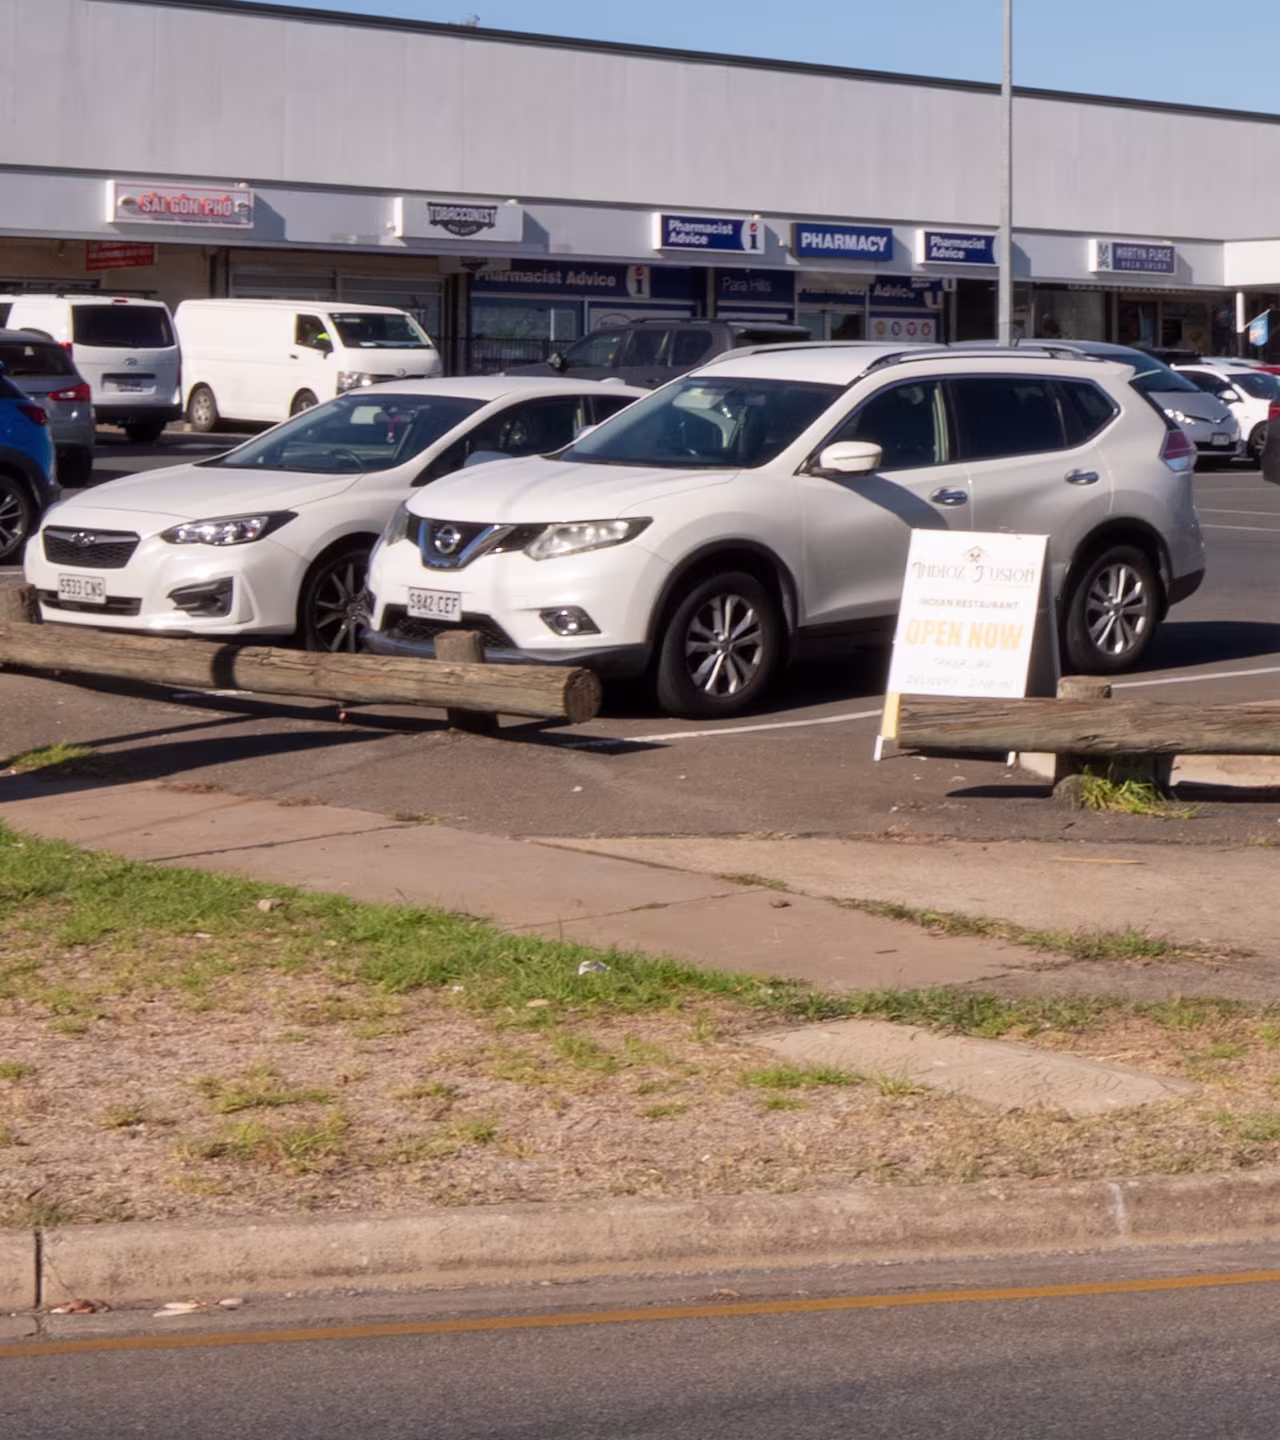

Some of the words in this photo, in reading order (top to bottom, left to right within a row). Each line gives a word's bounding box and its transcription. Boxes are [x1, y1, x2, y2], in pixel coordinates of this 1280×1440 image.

[429, 206, 496, 225] TOBACCONIST
[668, 219, 733, 235] Pharmacist
[668, 231, 709, 245] Advice
[801, 232, 888, 252] PHARMACY
[930, 235, 986, 250] Pharmacist
[930, 247, 965, 259] Advice
[566, 270, 617, 288] Advice
[722, 277, 748, 292] Para
[750, 278, 772, 293] Hills
[919, 598, 954, 608] INDIAN
[956, 599, 1019, 610] RESTAURANT
[905, 618, 964, 648] OPEN
[968, 622, 1024, 651] NOW
